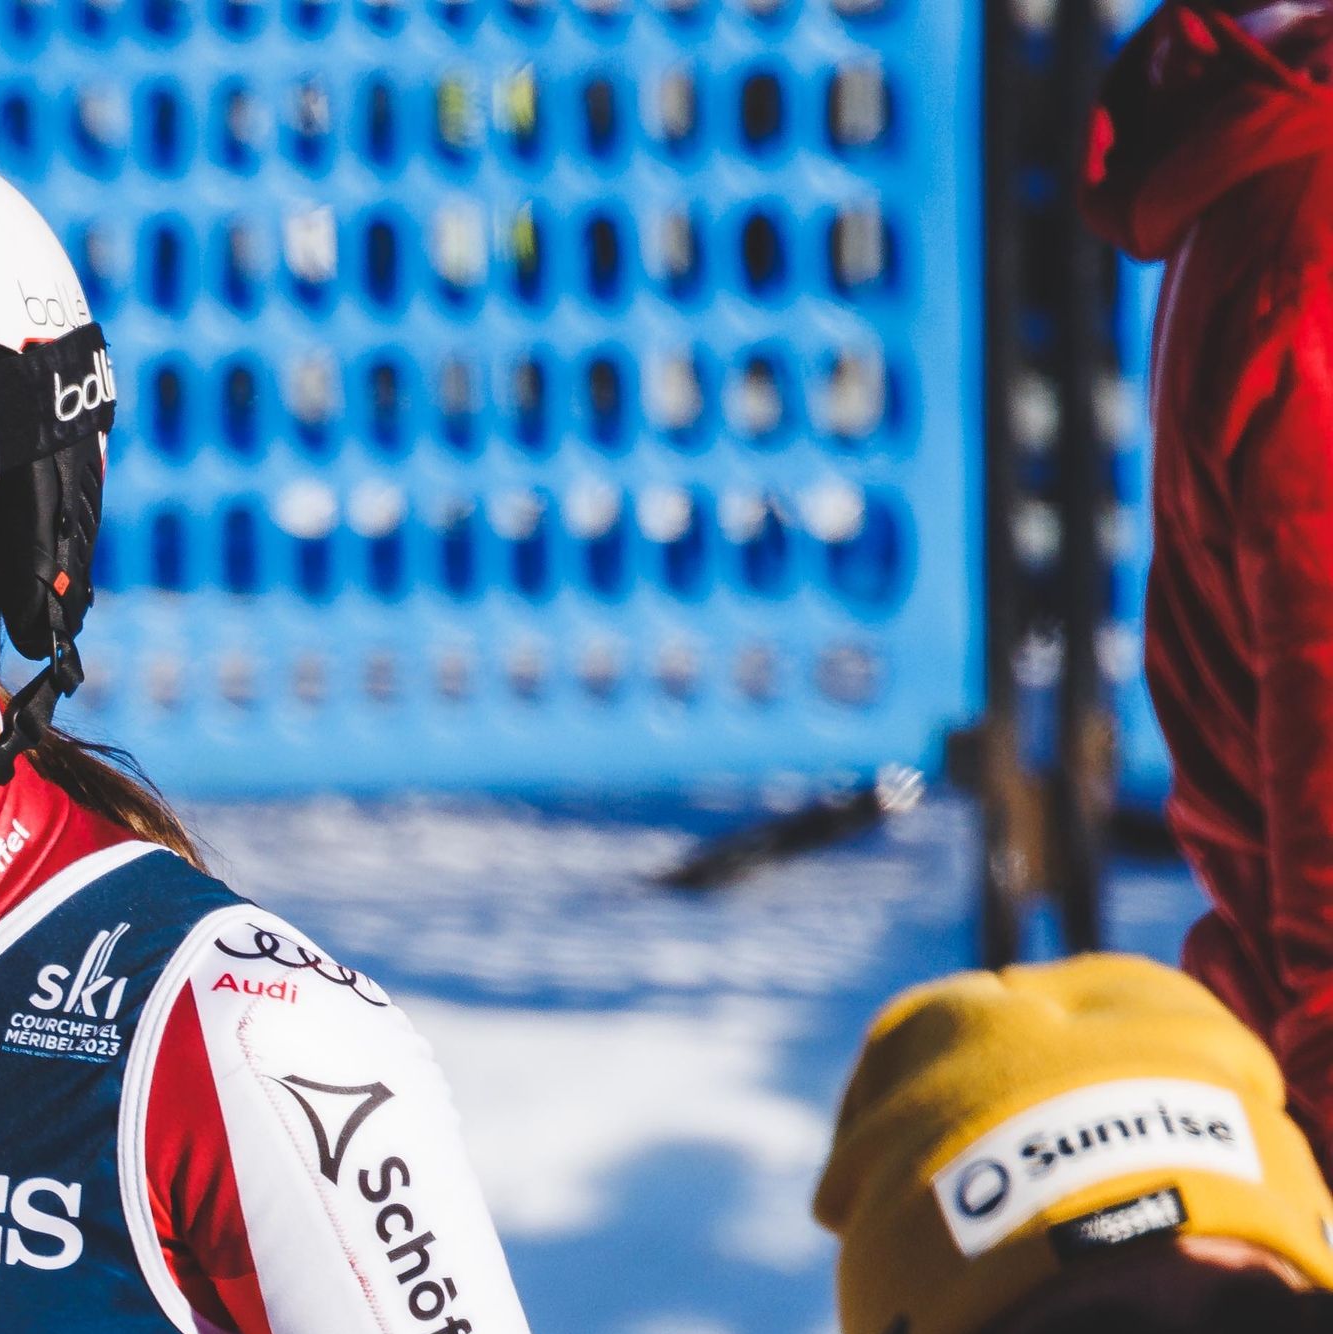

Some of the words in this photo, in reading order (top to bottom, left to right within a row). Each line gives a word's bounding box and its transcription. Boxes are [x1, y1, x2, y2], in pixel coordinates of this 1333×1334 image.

[212, 973, 299, 1004] Audi
[10, 1012, 123, 1040] COURCHEVEL
[4, 1028, 75, 1052] MÉRIBEL
[75, 1039, 121, 1057] 2023
[1019, 1099, 1236, 1178] Sunrise
